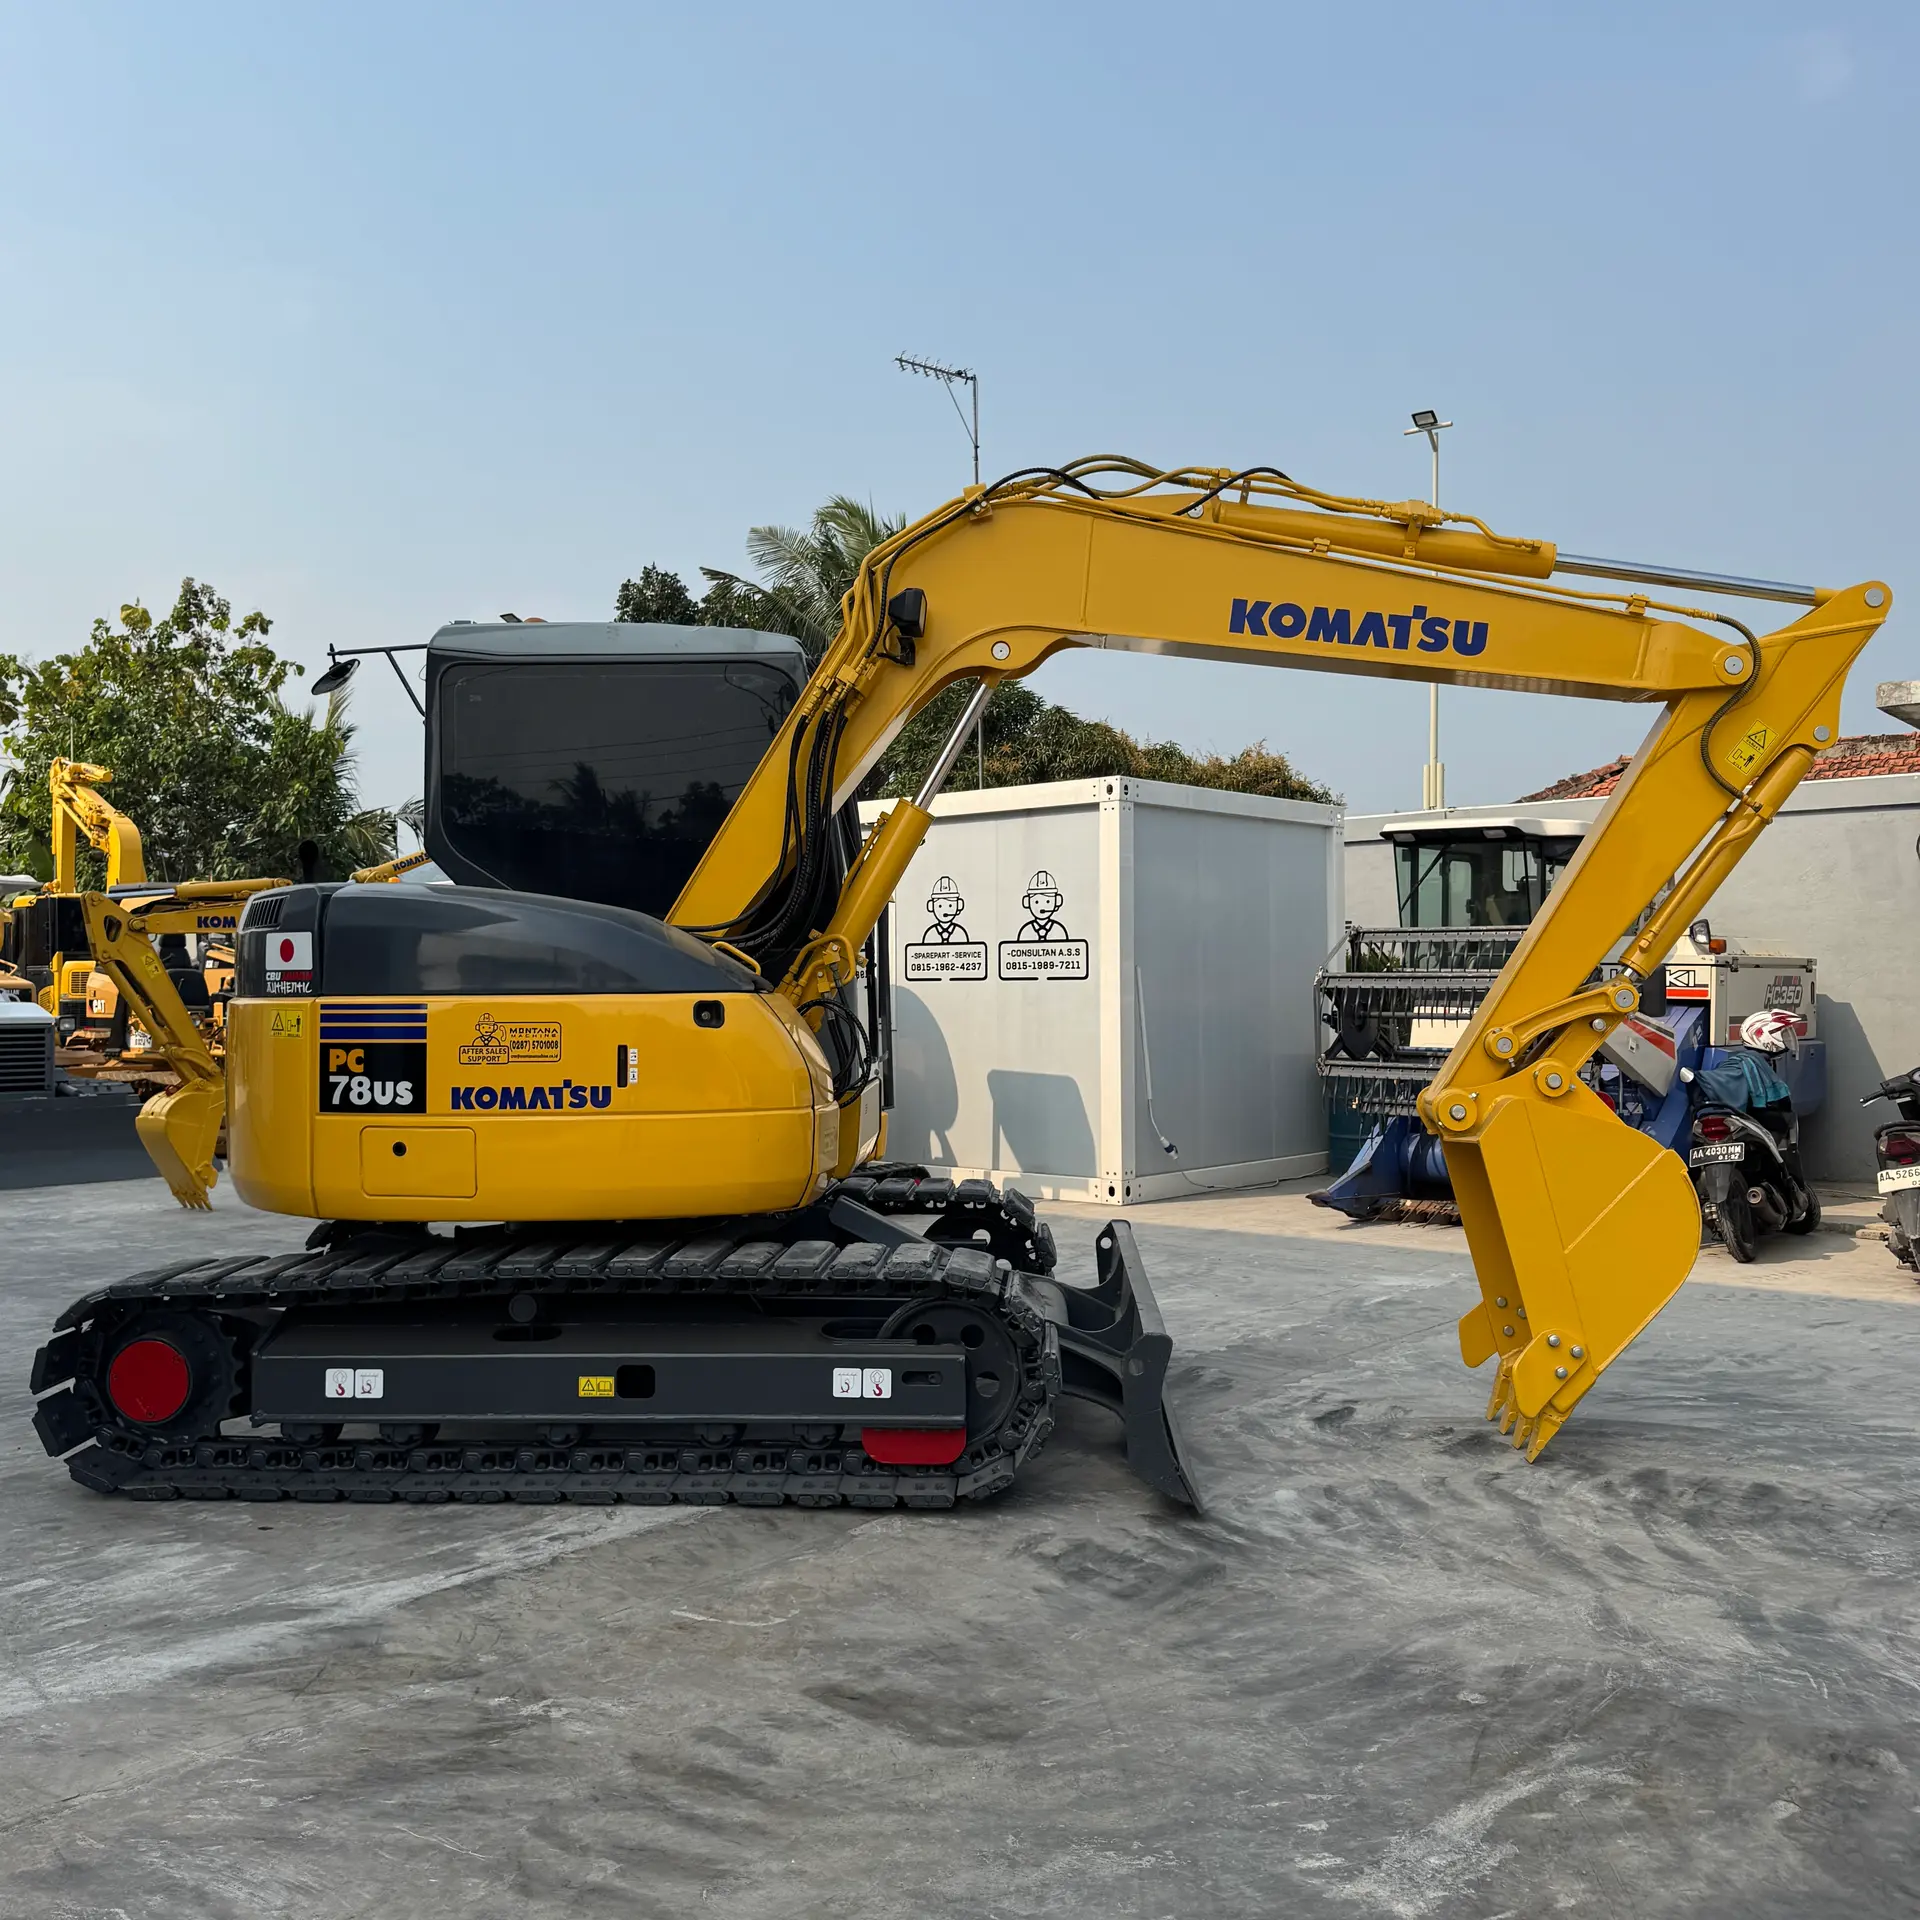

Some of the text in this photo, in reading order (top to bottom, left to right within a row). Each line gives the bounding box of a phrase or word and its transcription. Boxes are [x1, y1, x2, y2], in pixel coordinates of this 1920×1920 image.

[1229, 598, 1488, 656] KOMATSU
[266, 972, 281, 981] CBU
[92, 999, 106, 1014] CAT
[1764, 984, 1803, 1009] HC350
[485, 1047, 507, 1055] SALES
[510, 1040, 531, 1052] (0287)
[329, 1048, 365, 1073] PC
[451, 1079, 611, 1110] KOMATSU
